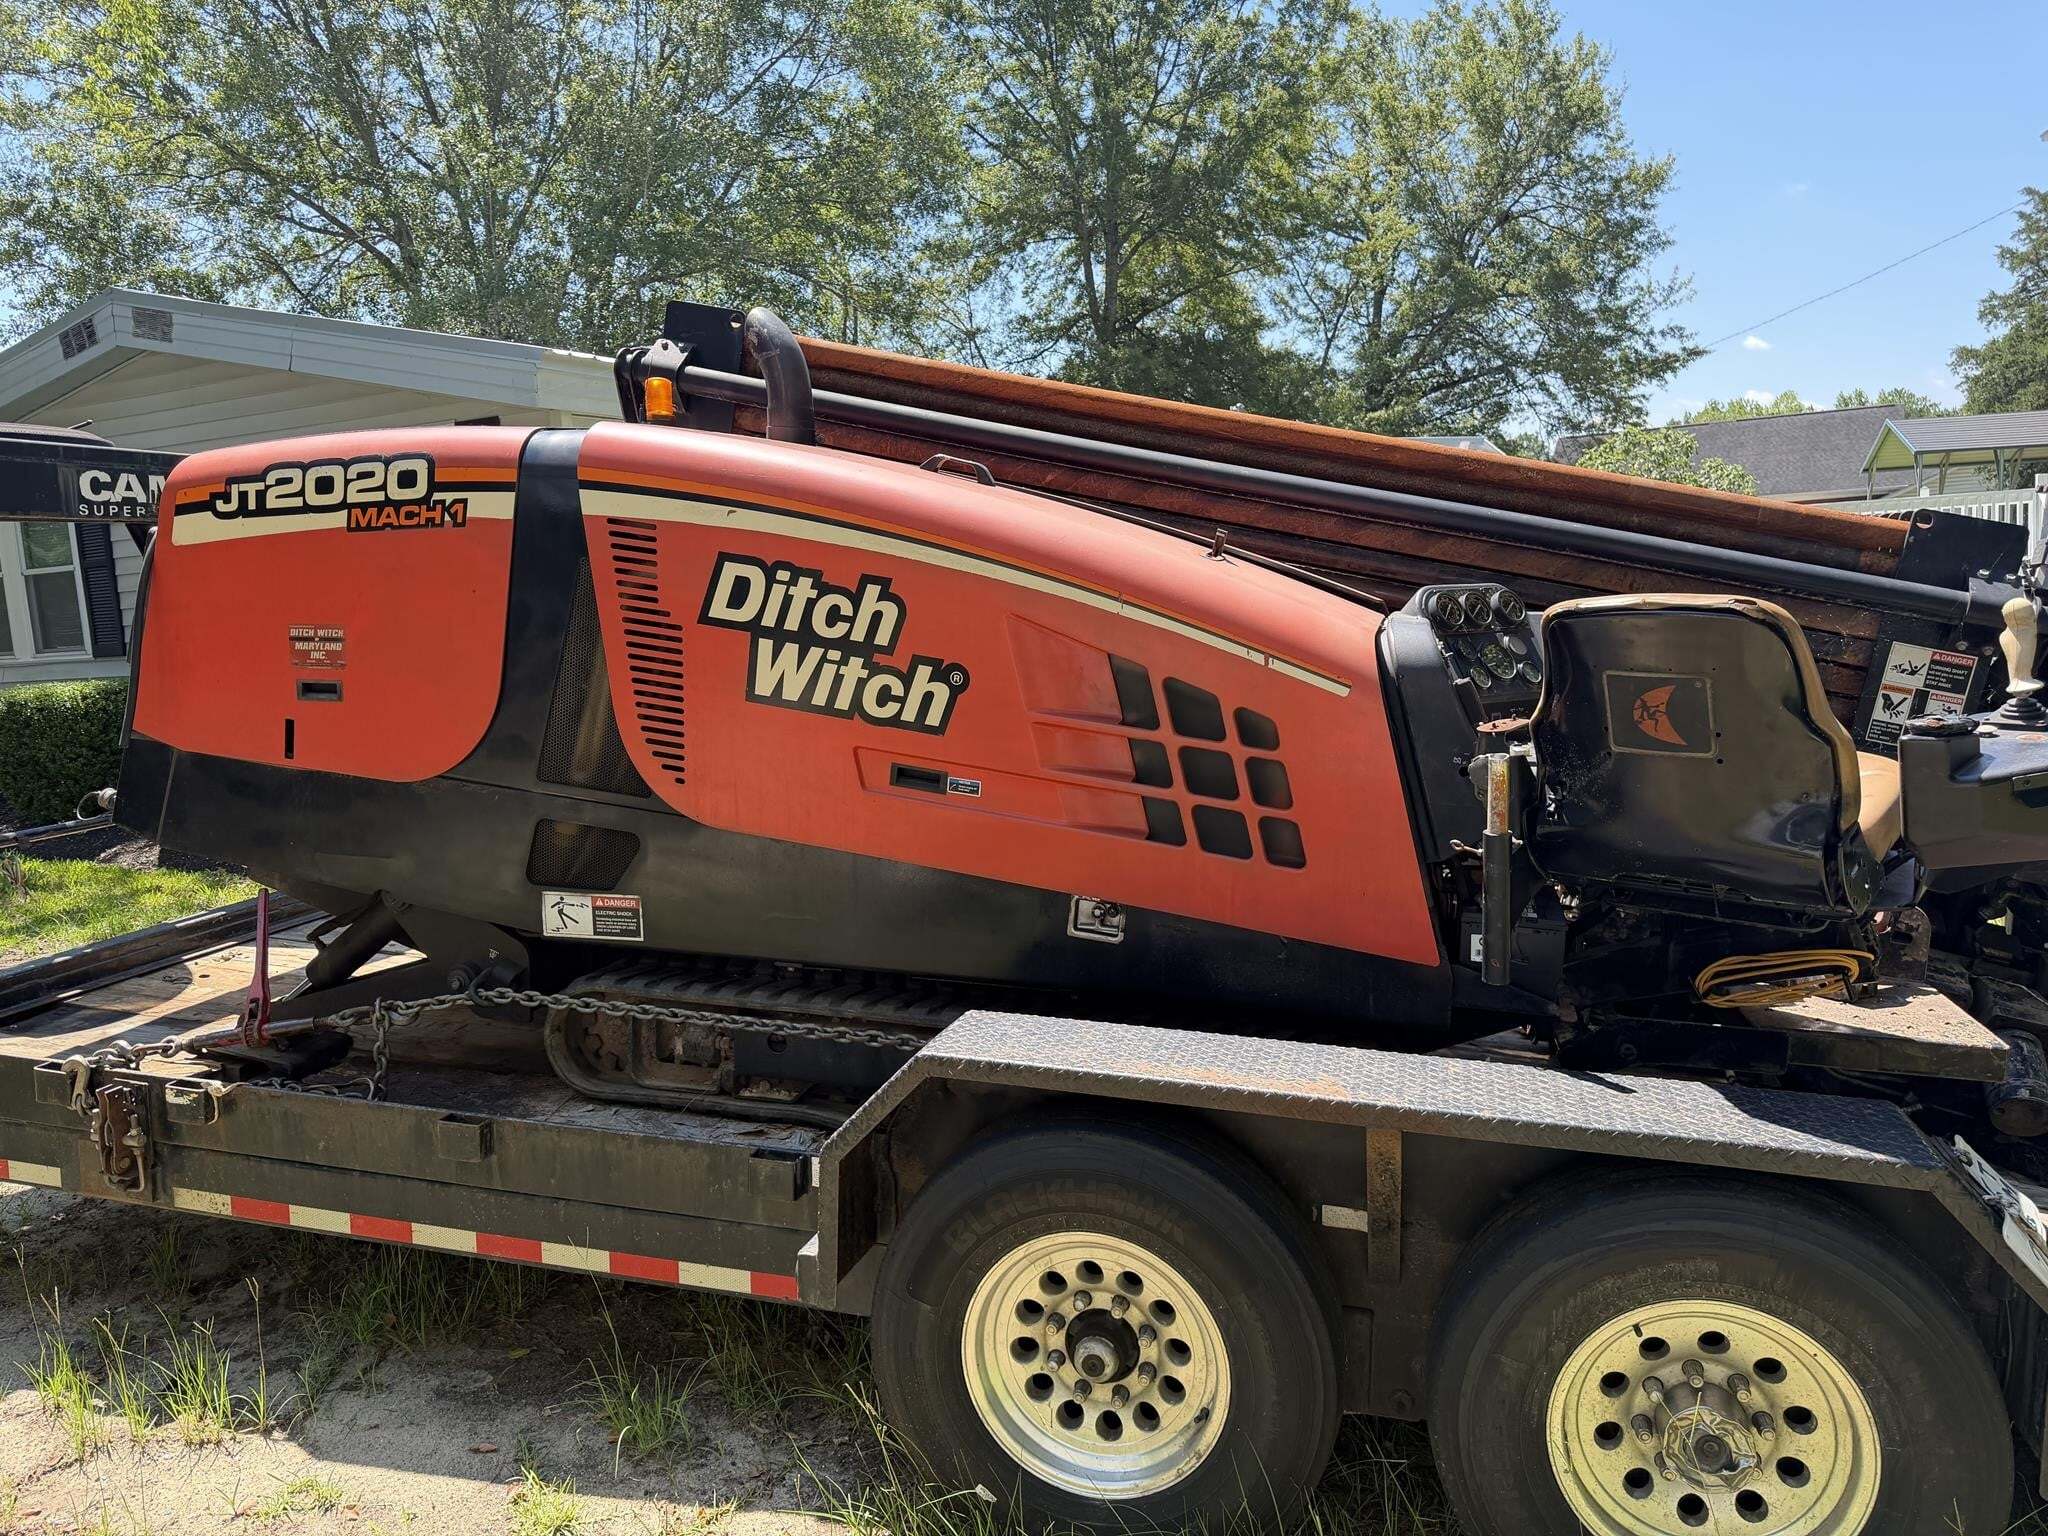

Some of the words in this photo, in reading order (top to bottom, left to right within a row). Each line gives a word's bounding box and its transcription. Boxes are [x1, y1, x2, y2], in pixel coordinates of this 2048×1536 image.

[215, 459, 427, 512] JT2020
[351, 504, 440, 528] MACH
[450, 503, 464, 523] 1
[708, 561, 899, 647] Ditch
[290, 628, 315, 637] DITCH
[317, 629, 344, 637] WITCH
[295, 642, 342, 650] MARYLAND
[1941, 654, 1974, 666] DANGER
[1936, 694, 1963, 705] DANGER
[604, 899, 636, 907] DANGER
